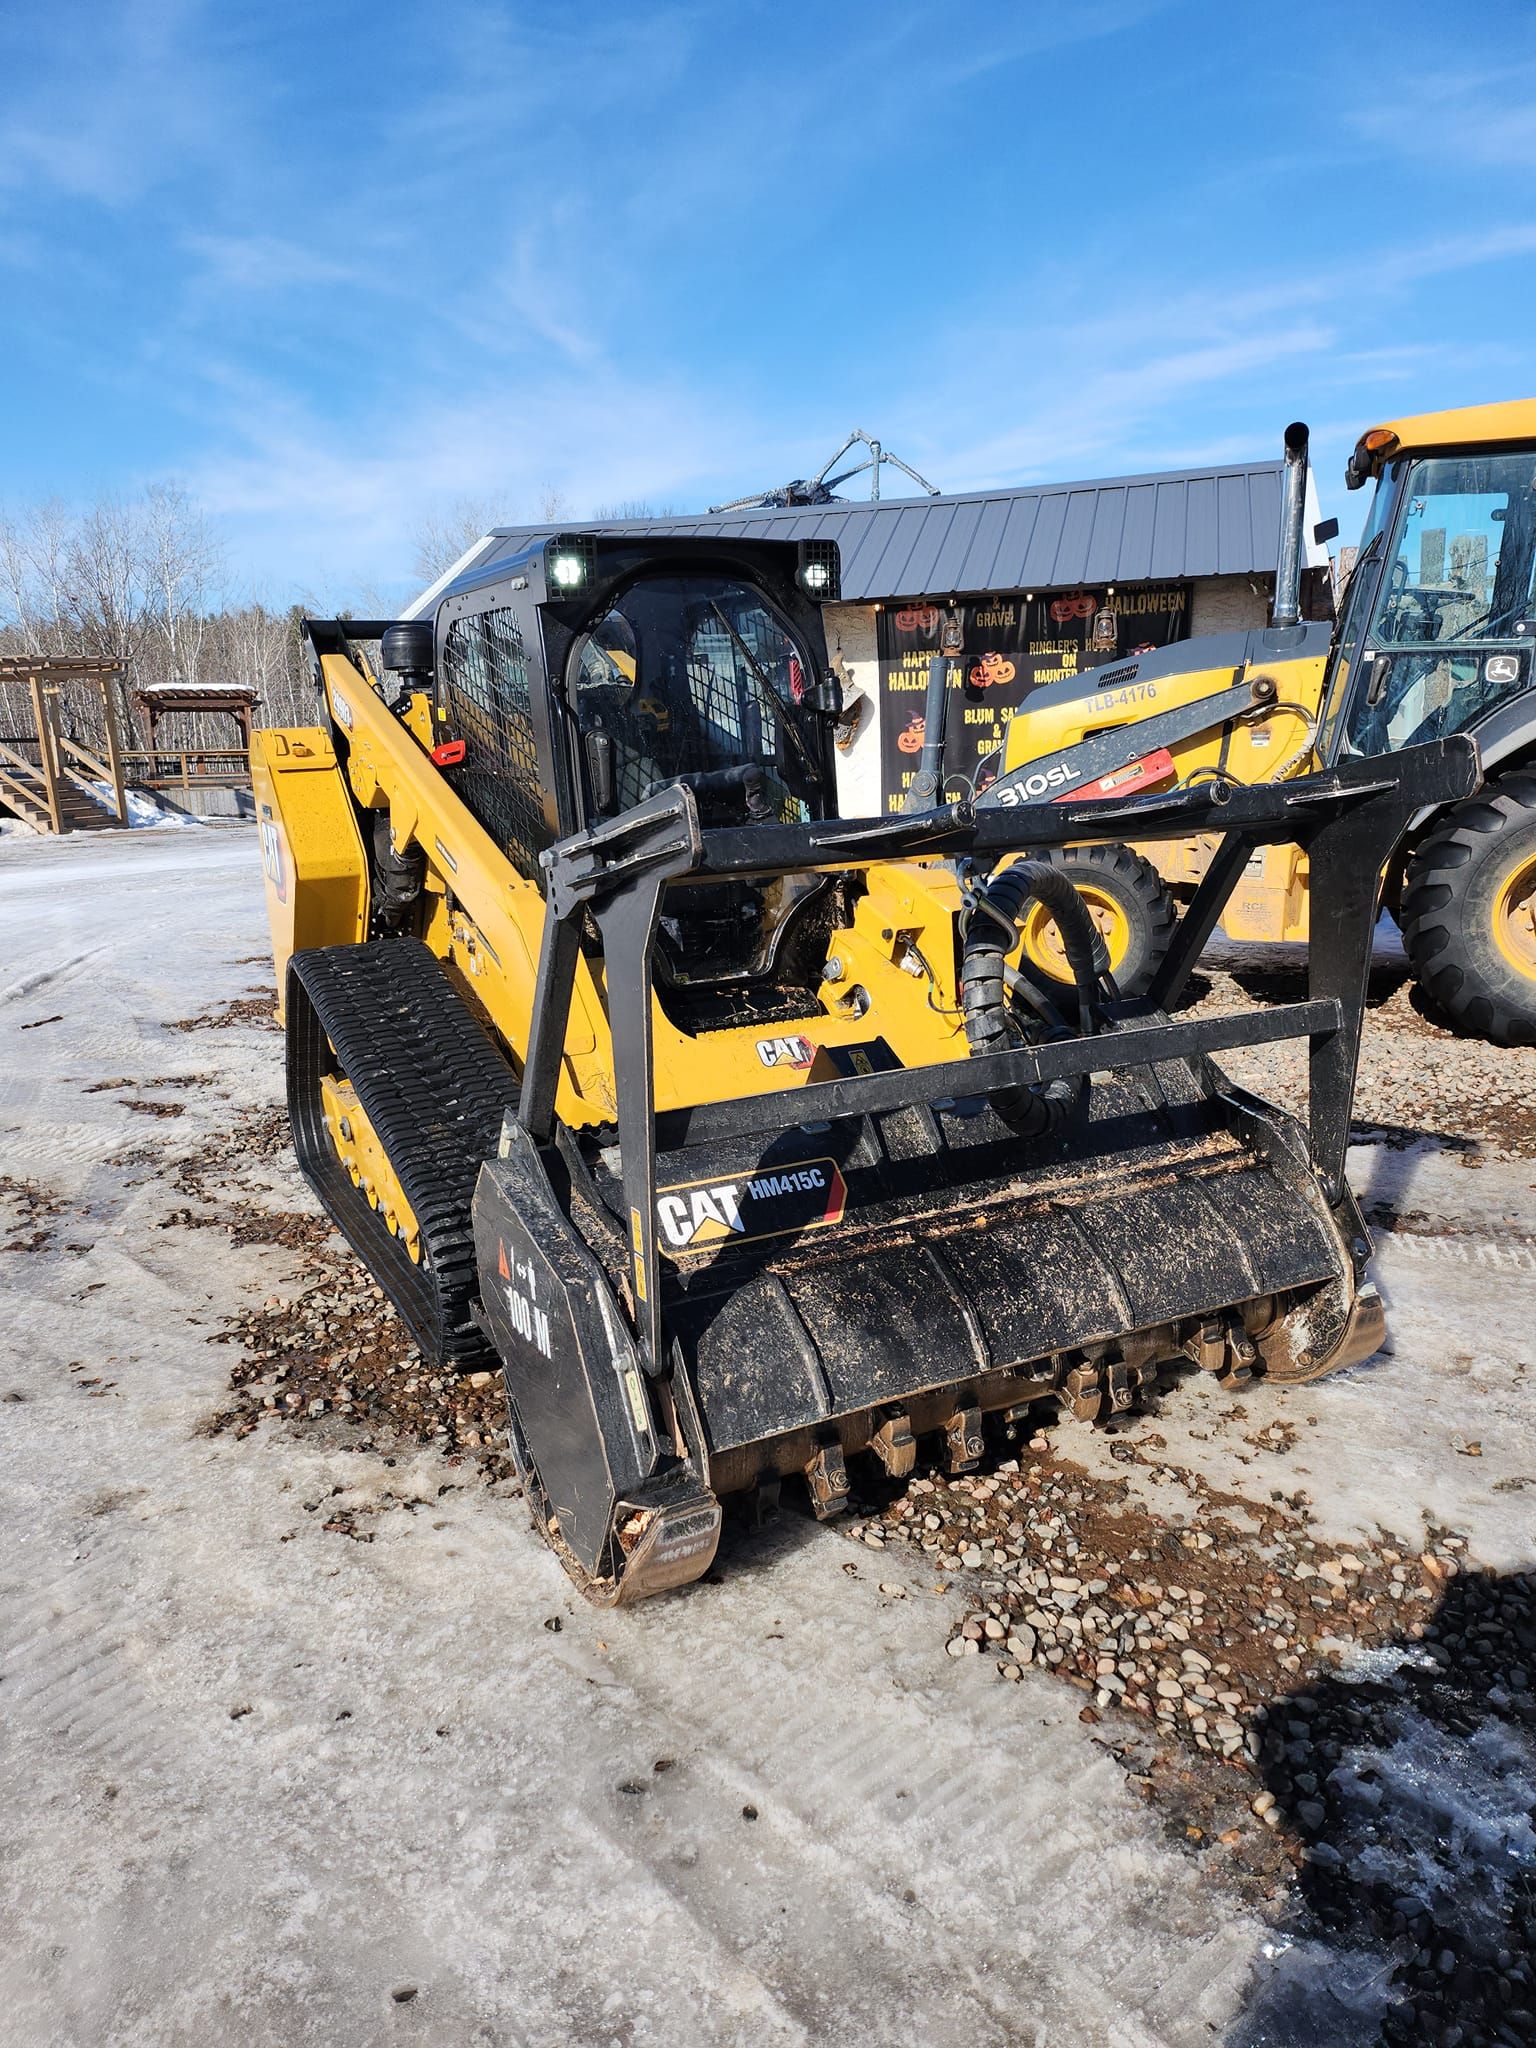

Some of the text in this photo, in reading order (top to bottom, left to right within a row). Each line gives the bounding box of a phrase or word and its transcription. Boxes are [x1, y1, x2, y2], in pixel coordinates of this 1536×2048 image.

[1105, 591, 1186, 616] HALLOWEEN
[976, 609, 1017, 628] GRAVEL
[1029, 638, 1079, 657] RINGLER'S
[1061, 652, 1077, 669] ON
[1085, 683, 1157, 714] TLB-4176
[963, 708, 994, 725] BLUM
[992, 724, 1002, 739] &
[997, 763, 1081, 808] 310SL
[261, 820, 282, 886] CAT
[757, 1036, 804, 1067] CAT
[657, 1185, 746, 1246] CAT
[748, 1168, 826, 1201] HM415C
